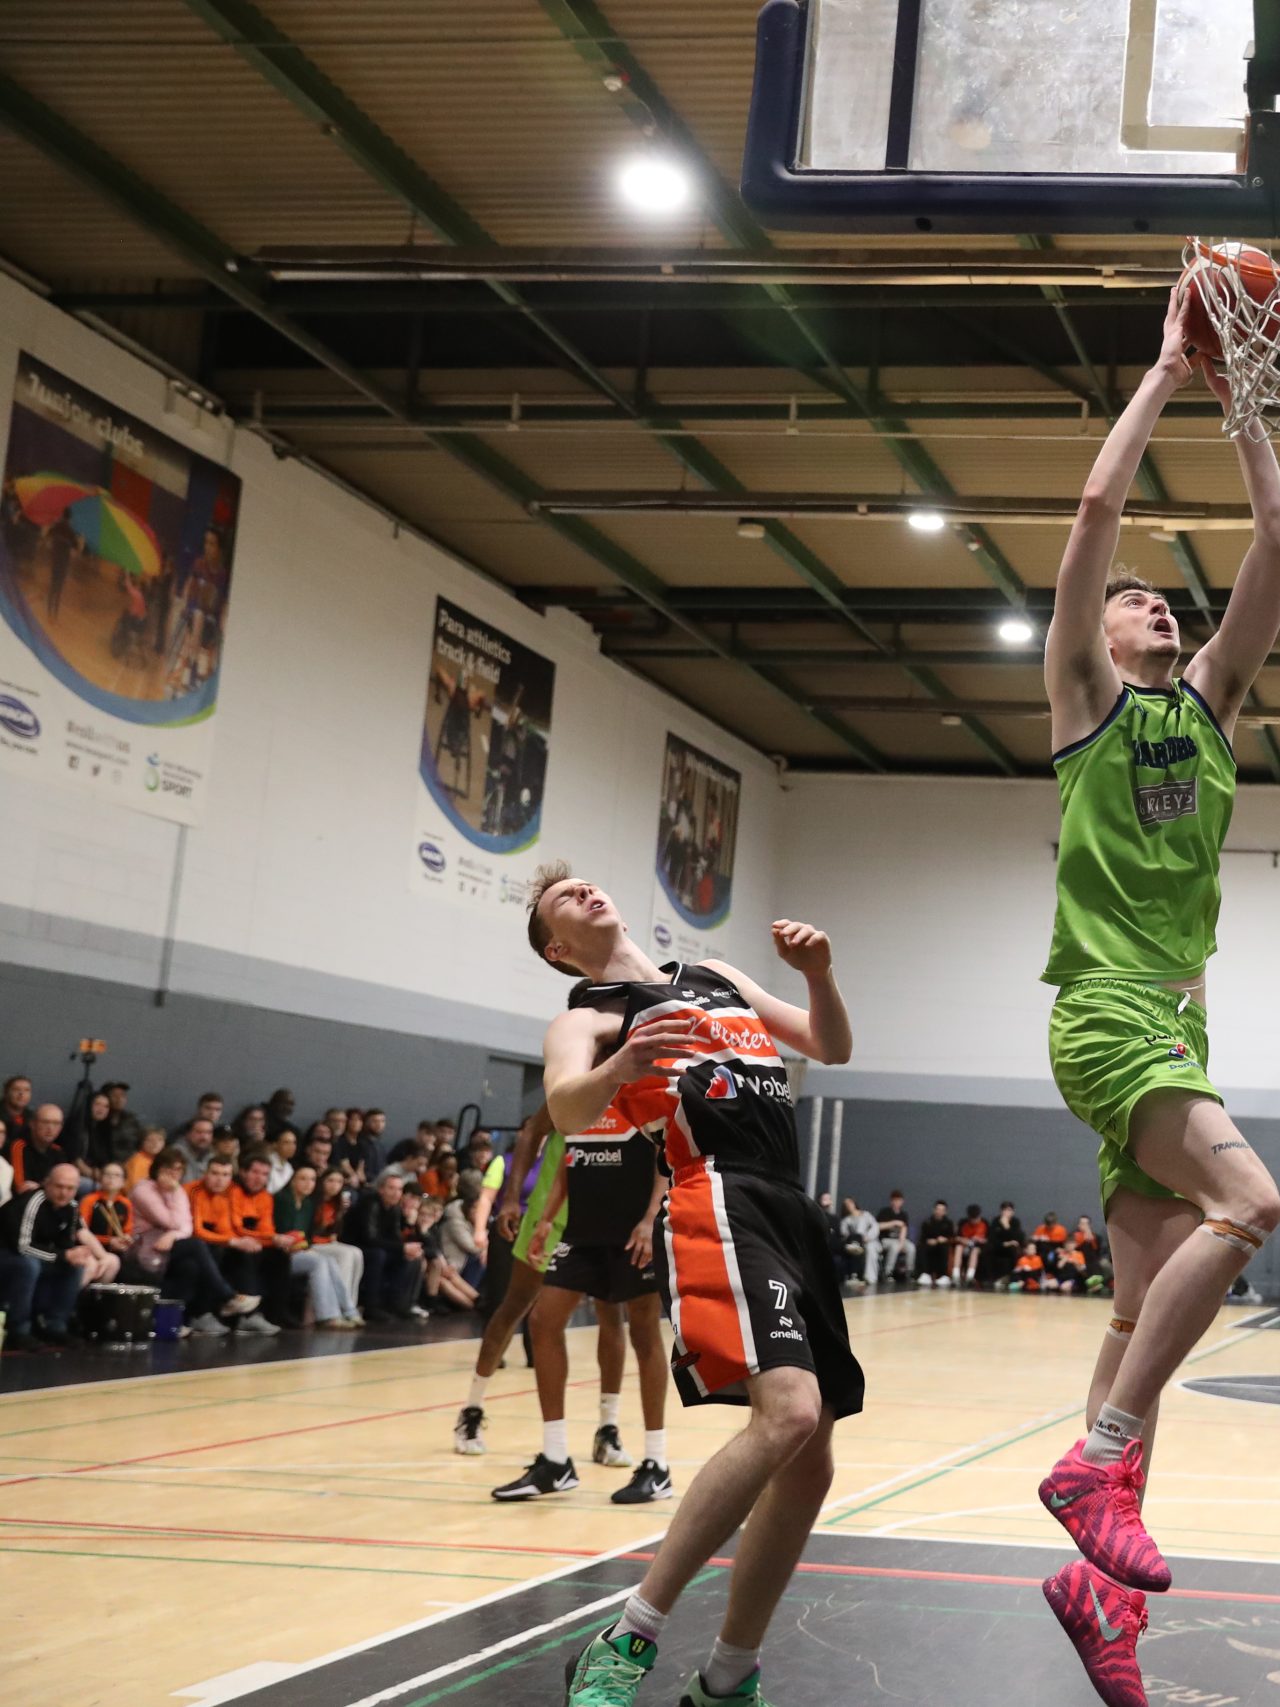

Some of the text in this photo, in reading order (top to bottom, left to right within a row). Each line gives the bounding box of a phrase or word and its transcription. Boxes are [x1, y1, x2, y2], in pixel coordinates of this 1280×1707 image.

[438, 608, 465, 639] Para
[575, 1149, 622, 1166] Pyrobel
[768, 1279, 788, 1310] 7
